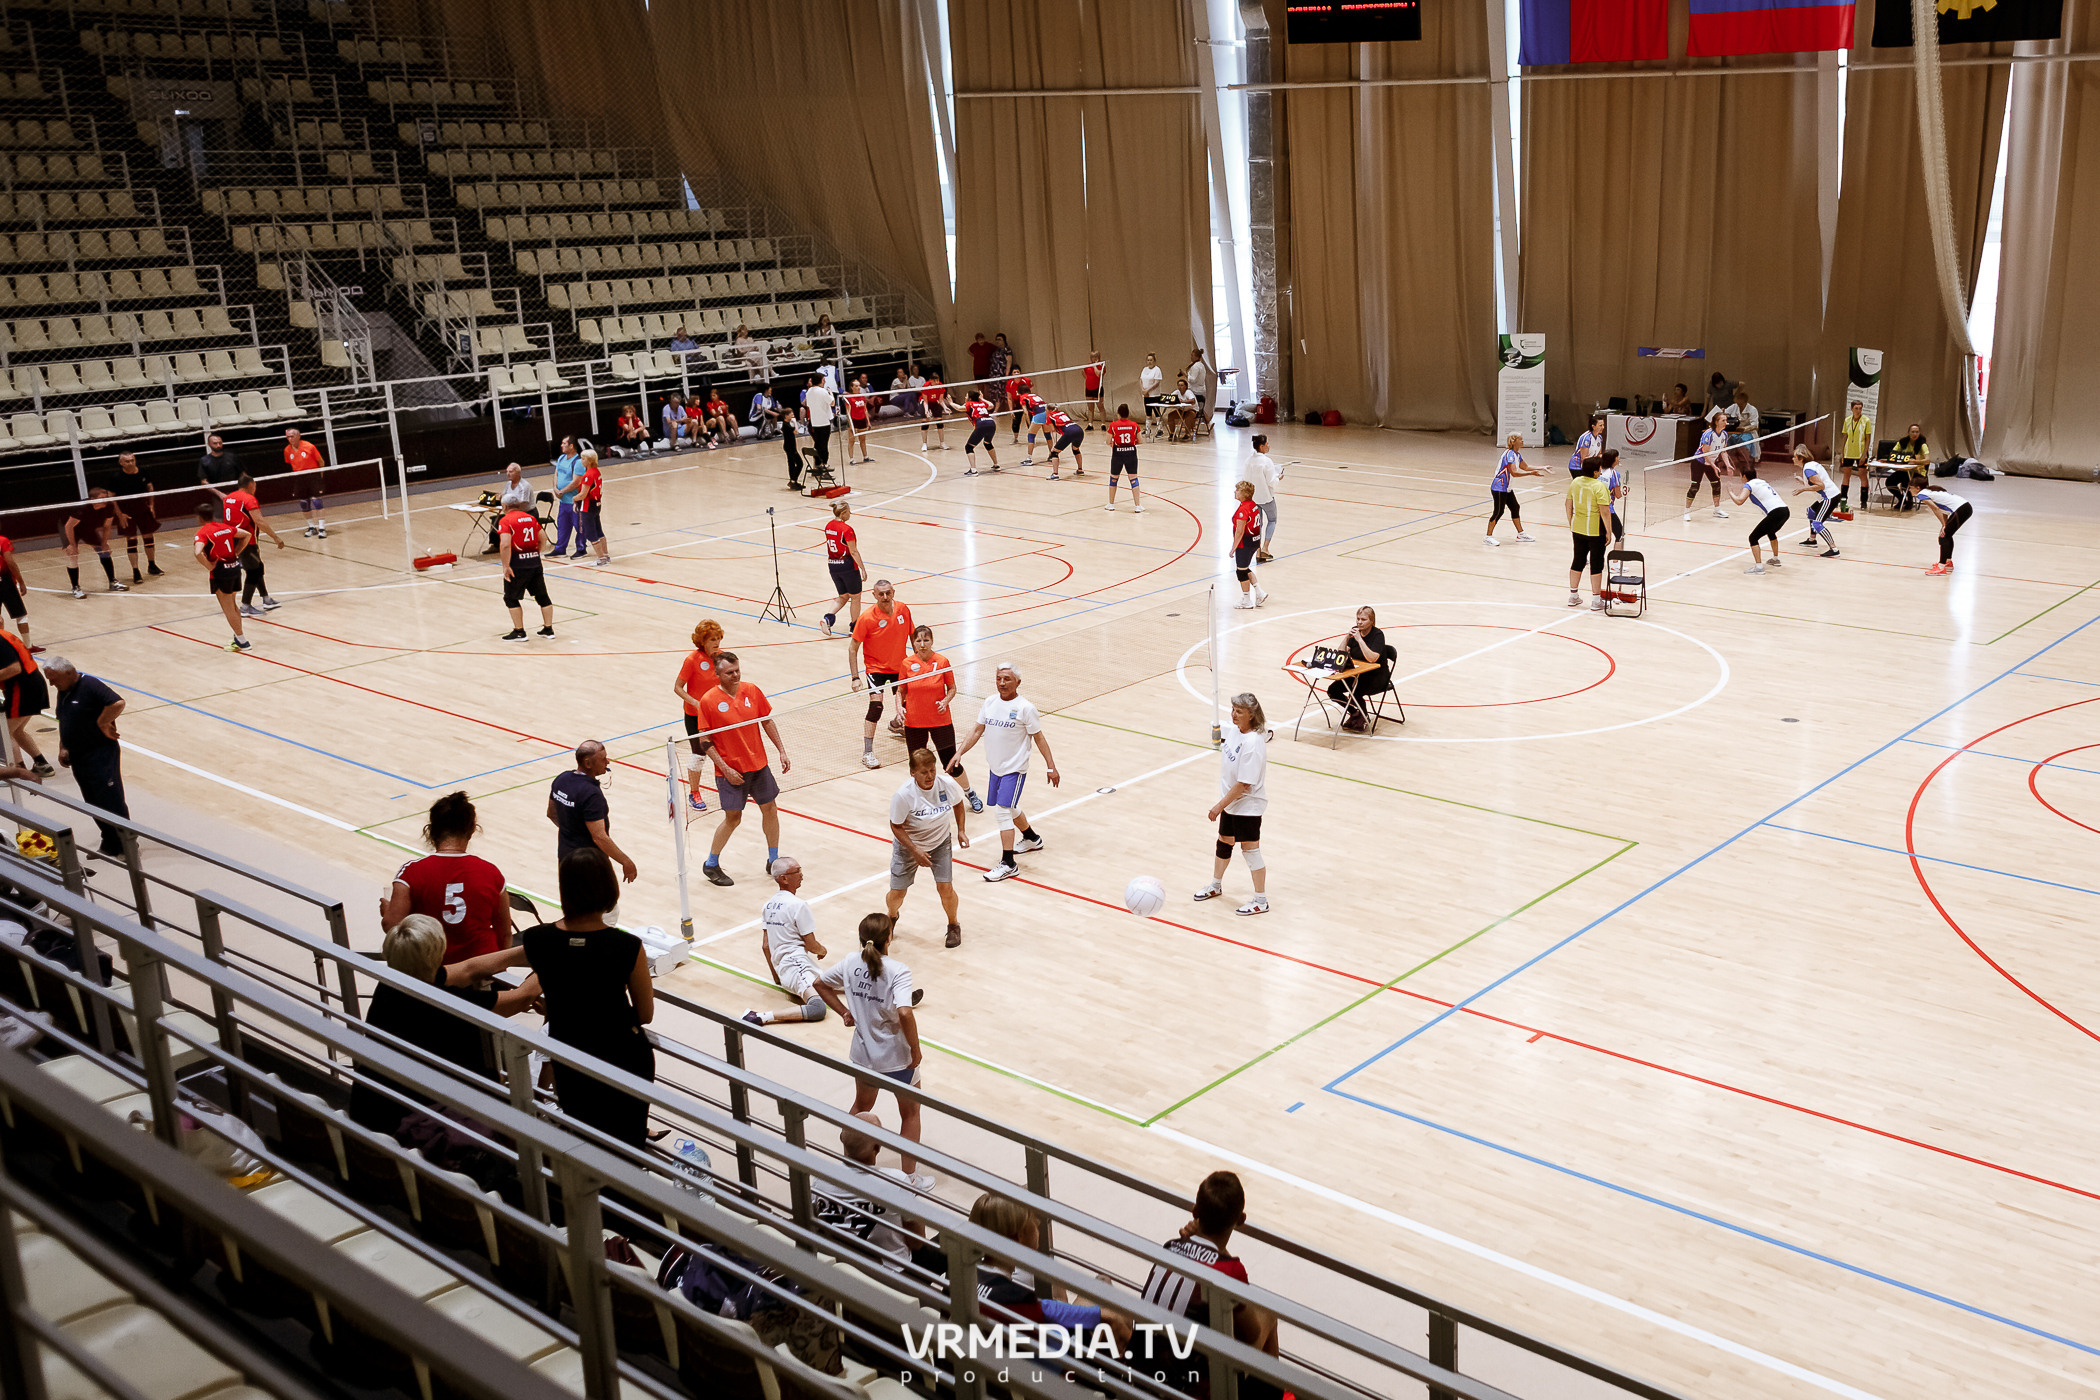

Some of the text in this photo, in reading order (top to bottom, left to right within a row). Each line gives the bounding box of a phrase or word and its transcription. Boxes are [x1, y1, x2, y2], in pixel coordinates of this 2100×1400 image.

[1119, 433, 1131, 444] 13
[1889, 453, 1897, 462] 2
[1622, 485, 1628, 497] 3
[523, 527, 535, 542] 21
[827, 539, 838, 553] 15
[1316, 651, 1326, 663] 4
[1336, 654, 1346, 666] 0
[744, 696, 752, 708] 4
[442, 883, 467, 925] 5
[857, 980, 873, 991] ПГТ
